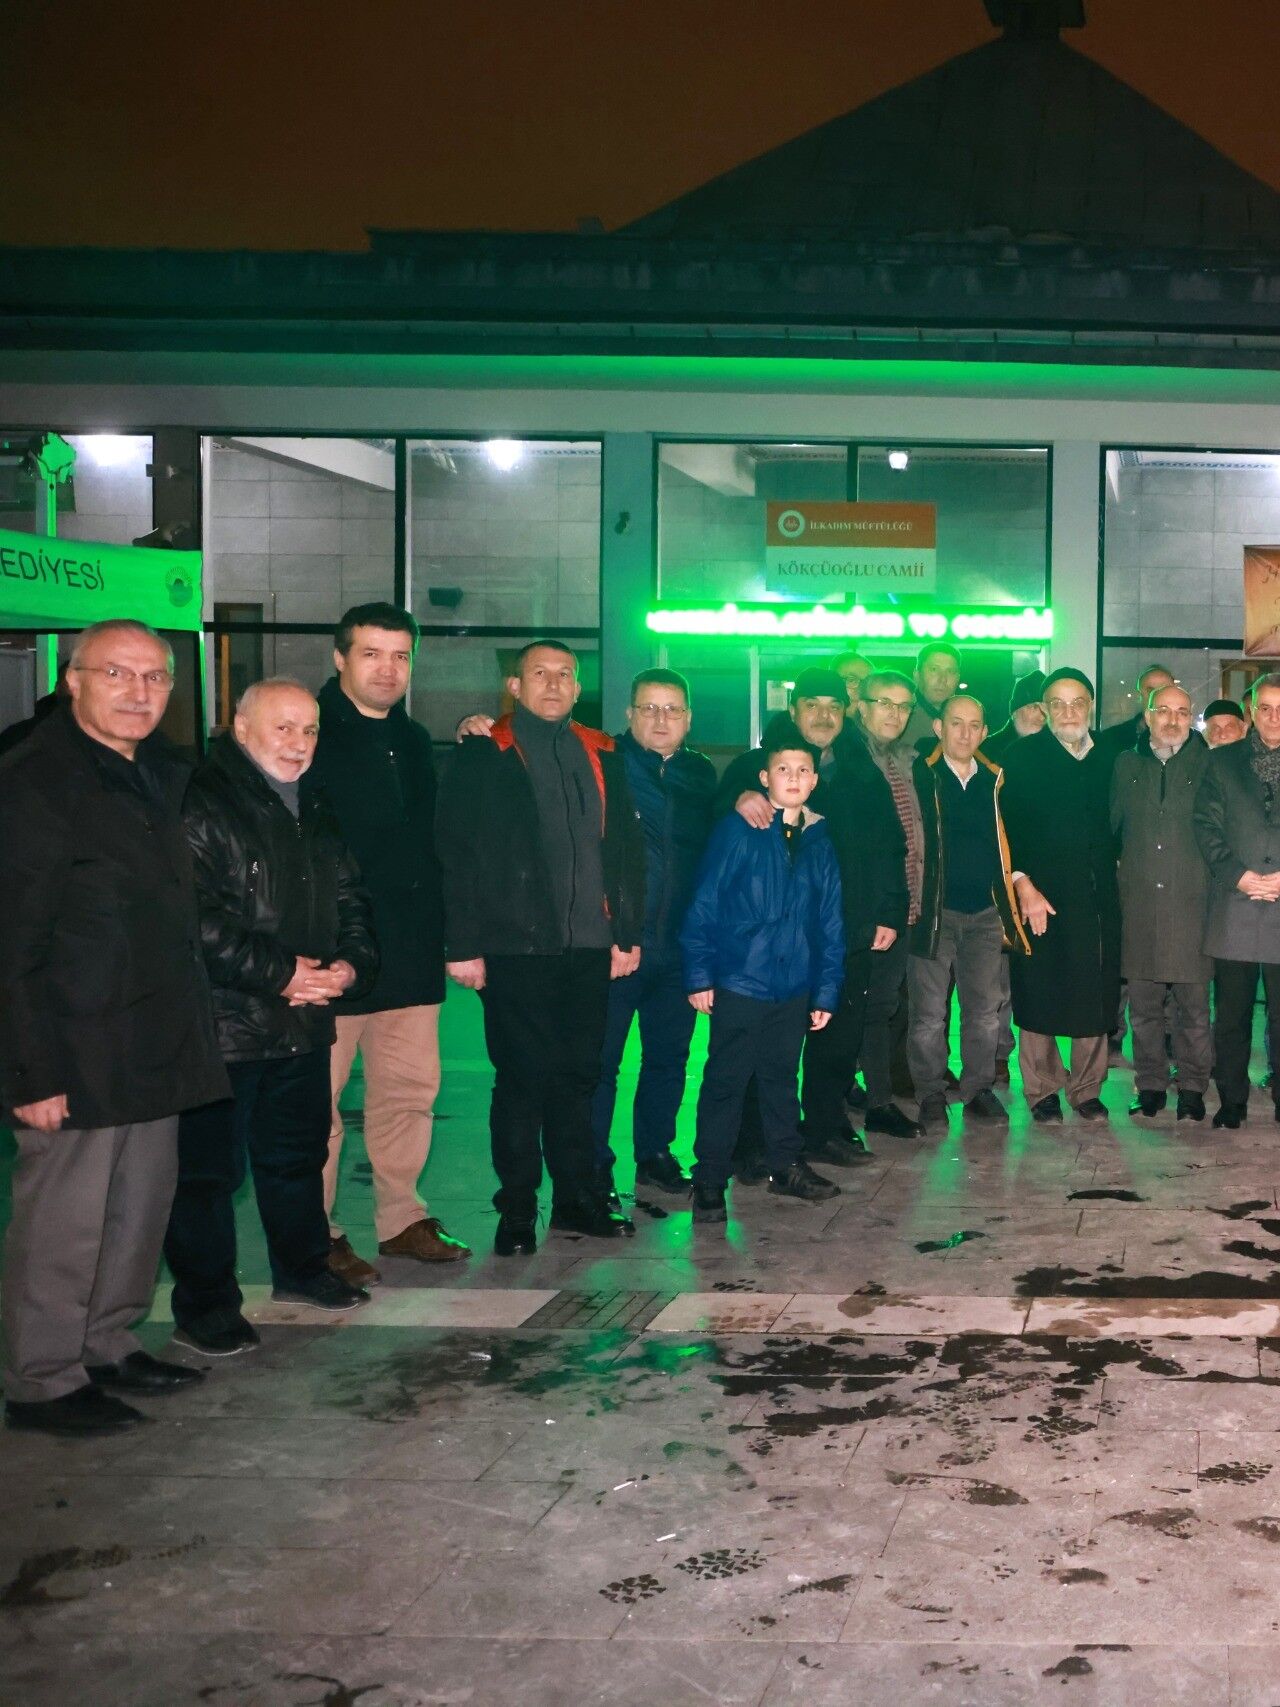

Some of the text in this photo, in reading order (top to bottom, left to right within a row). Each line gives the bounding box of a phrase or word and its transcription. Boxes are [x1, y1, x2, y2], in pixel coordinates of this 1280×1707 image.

[0, 547, 104, 591] EDİYESİ
[778, 560, 924, 578] KÖKÇÜOĞLU CAMİİ
